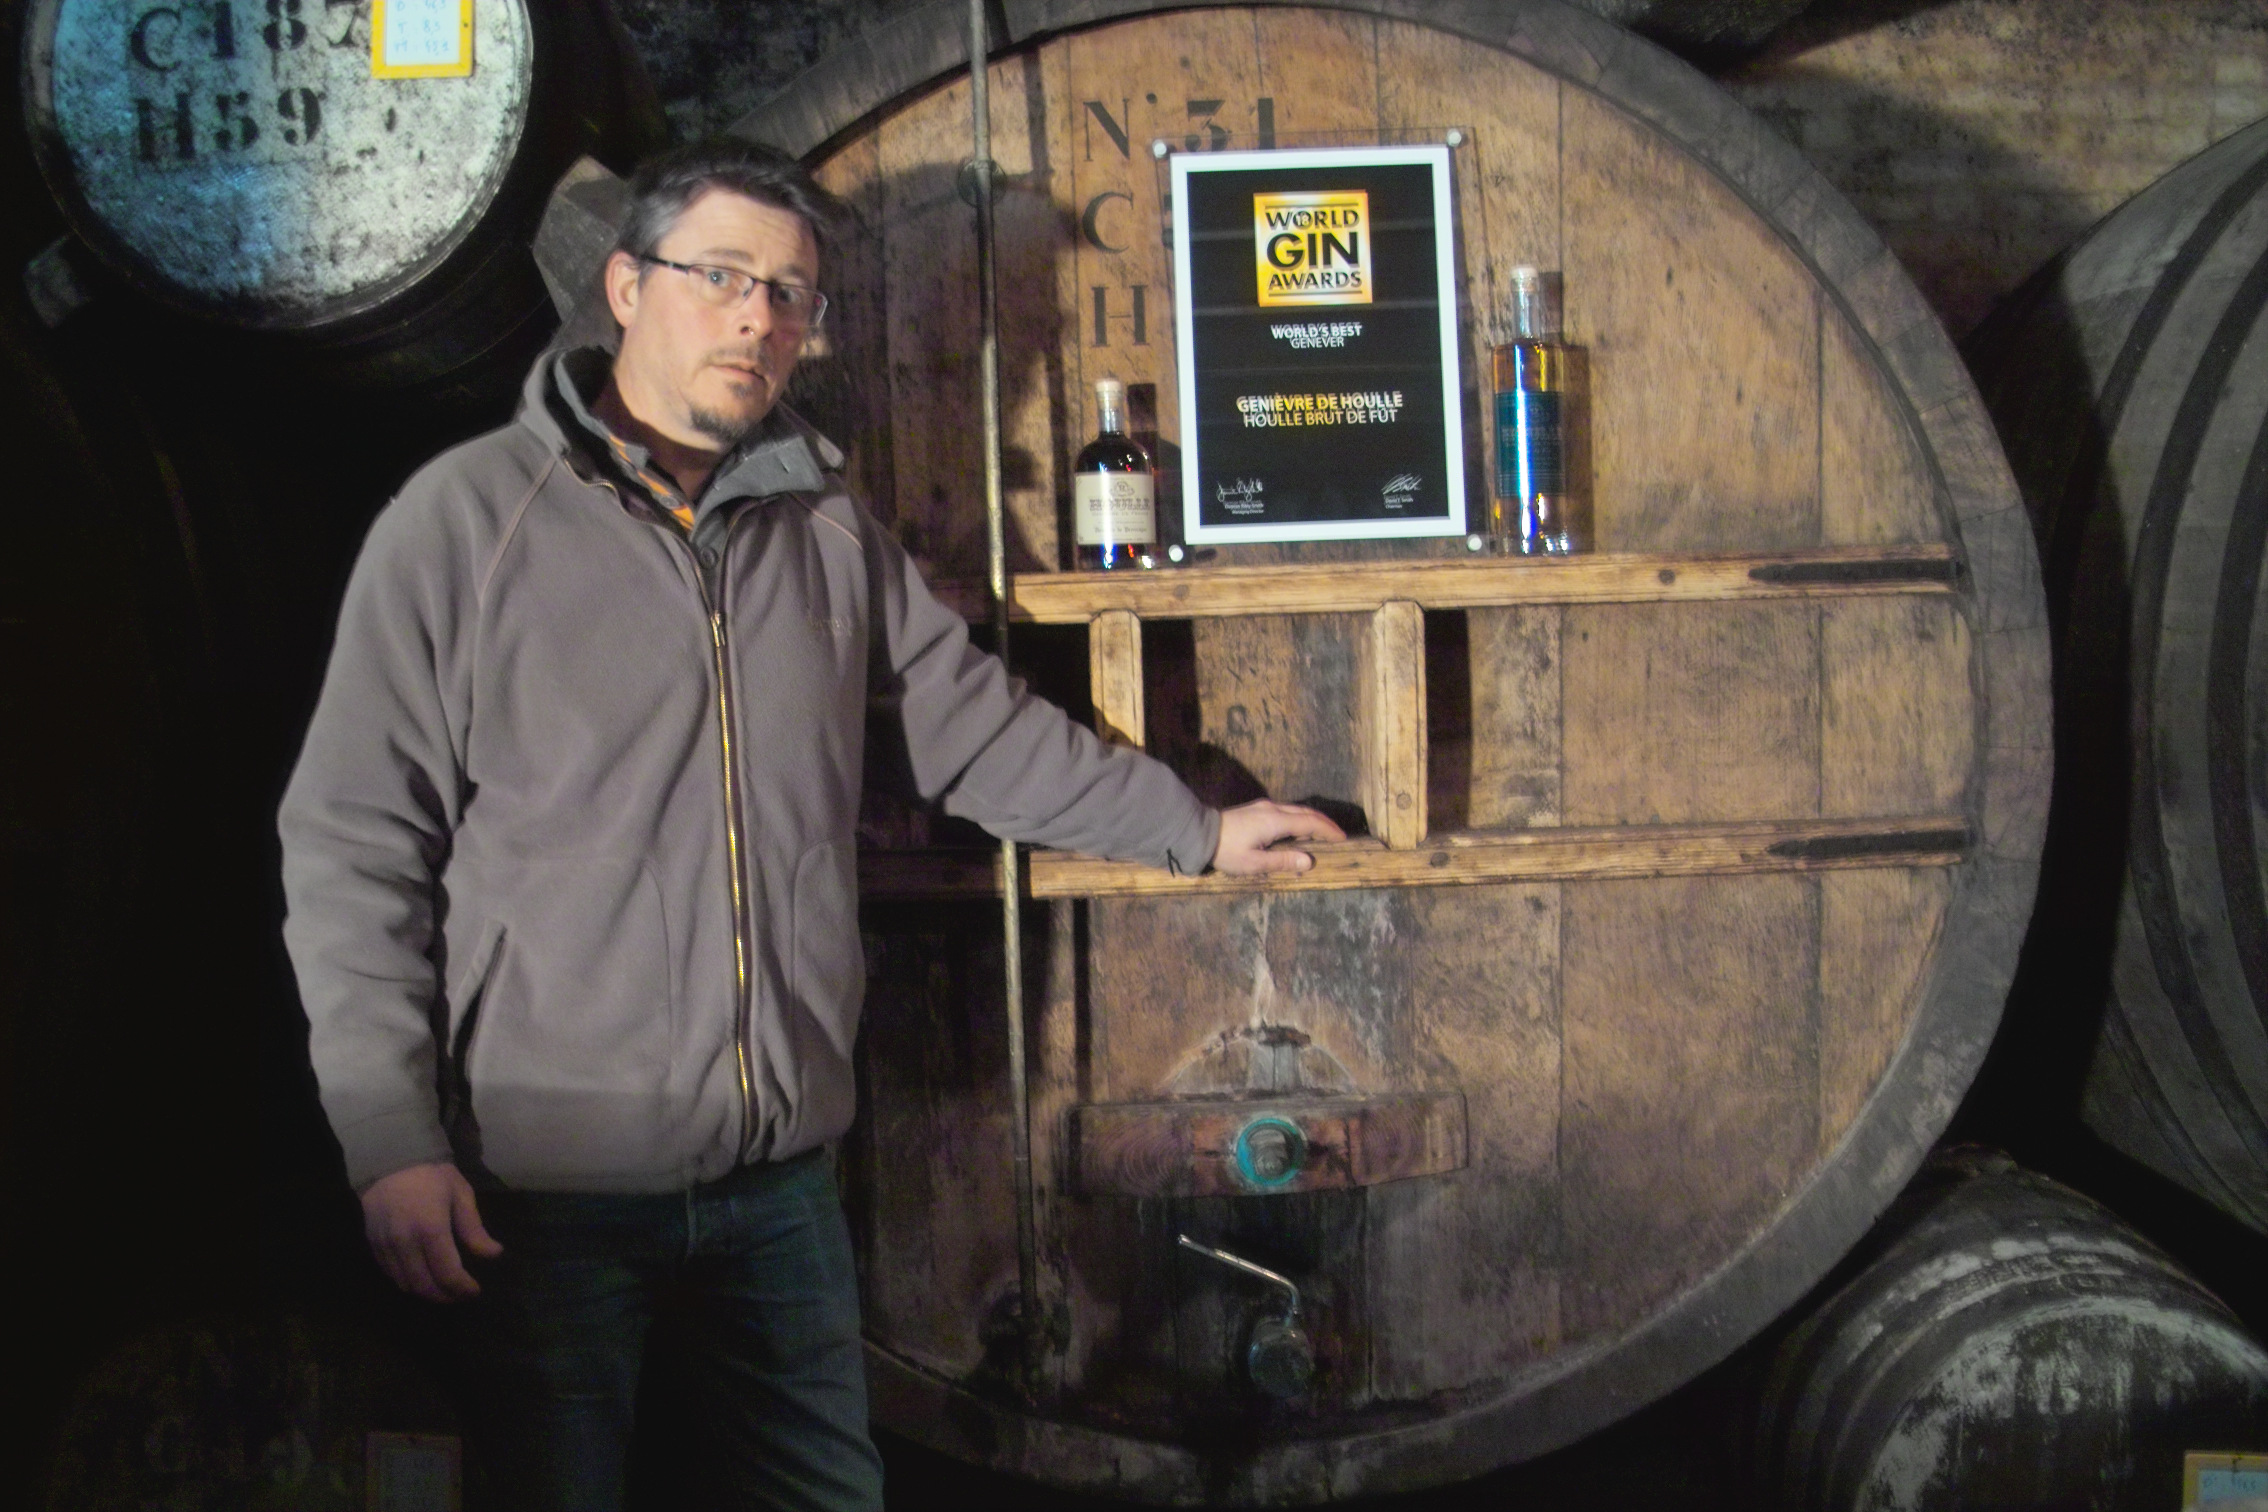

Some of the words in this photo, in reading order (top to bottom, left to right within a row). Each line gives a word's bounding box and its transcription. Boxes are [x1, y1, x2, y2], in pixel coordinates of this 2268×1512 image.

[1265, 208, 1359, 228] WORLD
[1266, 231, 1360, 268] GIN
[1269, 271, 1362, 289] AWARDS
[1272, 325, 1329, 339] WORLD'S
[1331, 324, 1362, 336] BEST
[1291, 336, 1345, 348] GENEVER
[1316, 397, 1338, 410] DE
[1341, 393, 1403, 409] HOULLE
[1245, 412, 1303, 427] HOULLE
[1306, 410, 1344, 426] BRUT
[1347, 409, 1367, 424] DE
